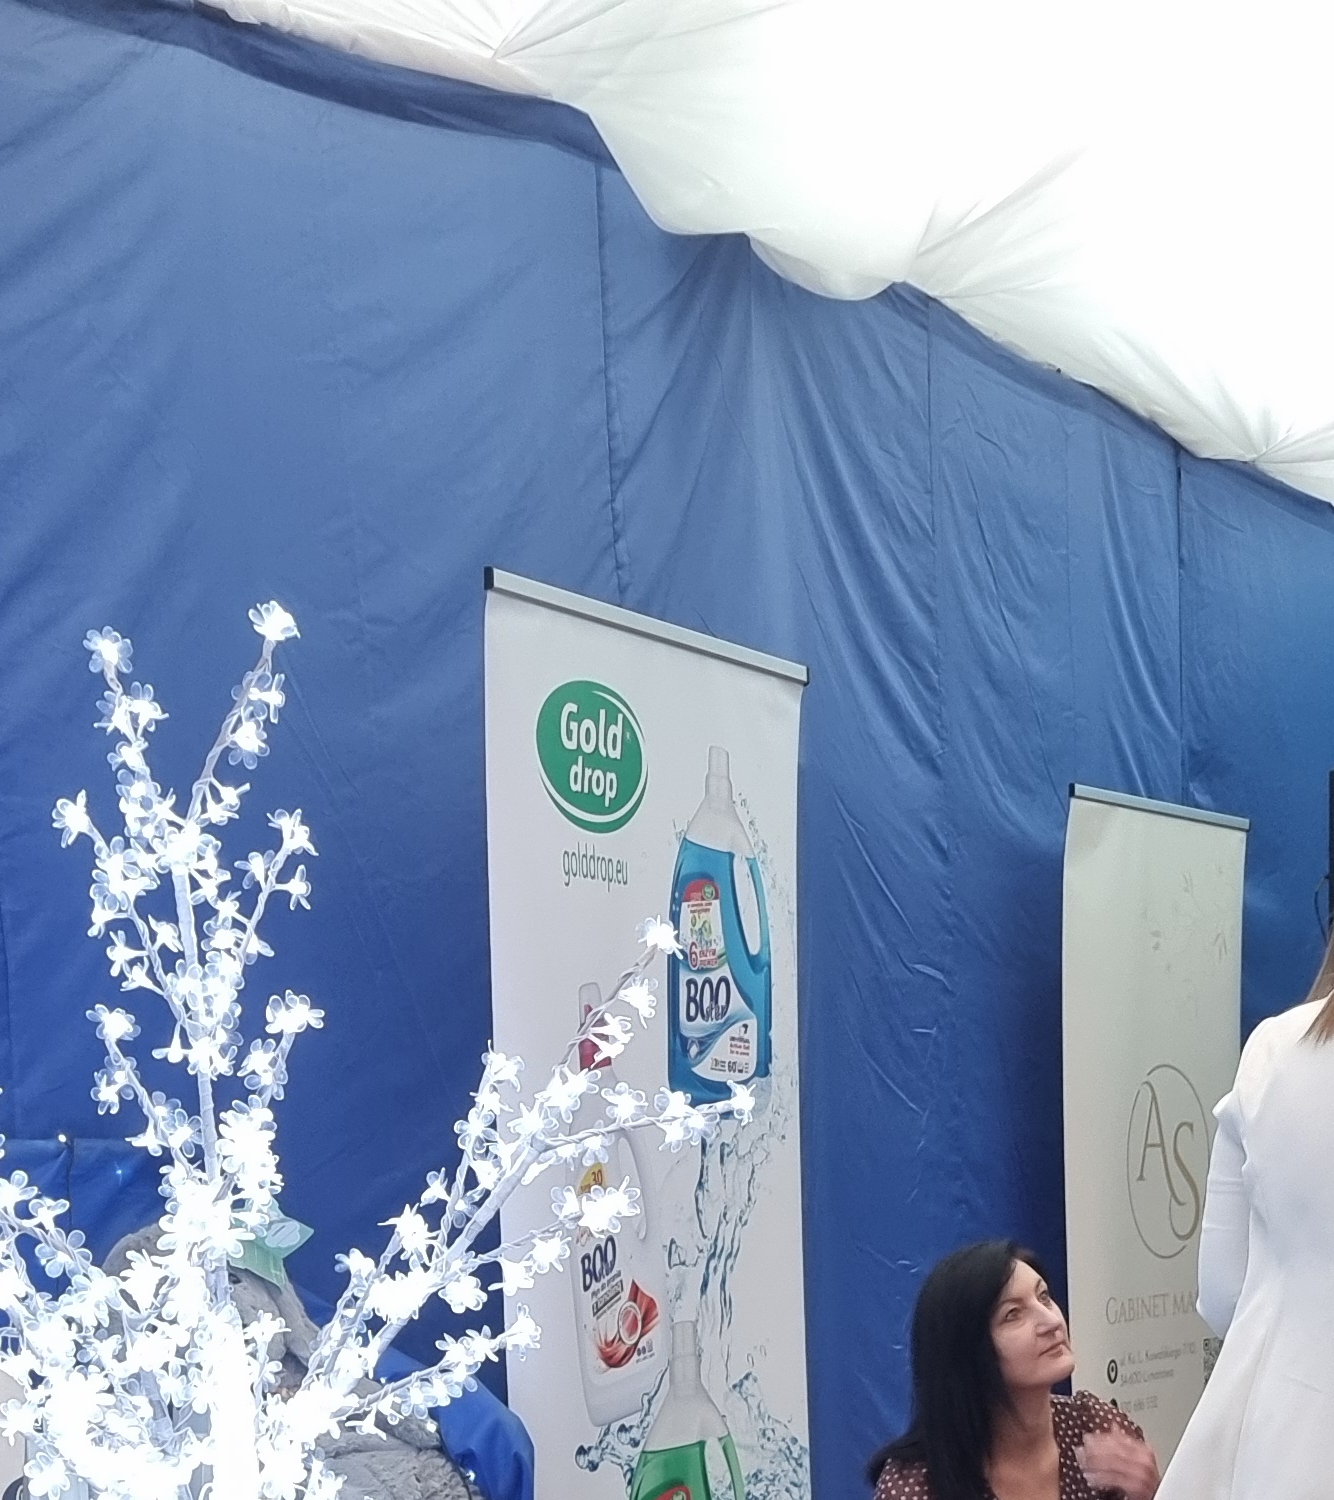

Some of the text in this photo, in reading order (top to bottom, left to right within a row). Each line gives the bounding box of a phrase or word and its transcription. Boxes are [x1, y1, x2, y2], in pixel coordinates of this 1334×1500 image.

[560, 702, 623, 760] Gold
[569, 756, 618, 807] drop
[562, 844, 628, 892] golddrop.eu
[1106, 1291, 1197, 1324] GABINET MA
